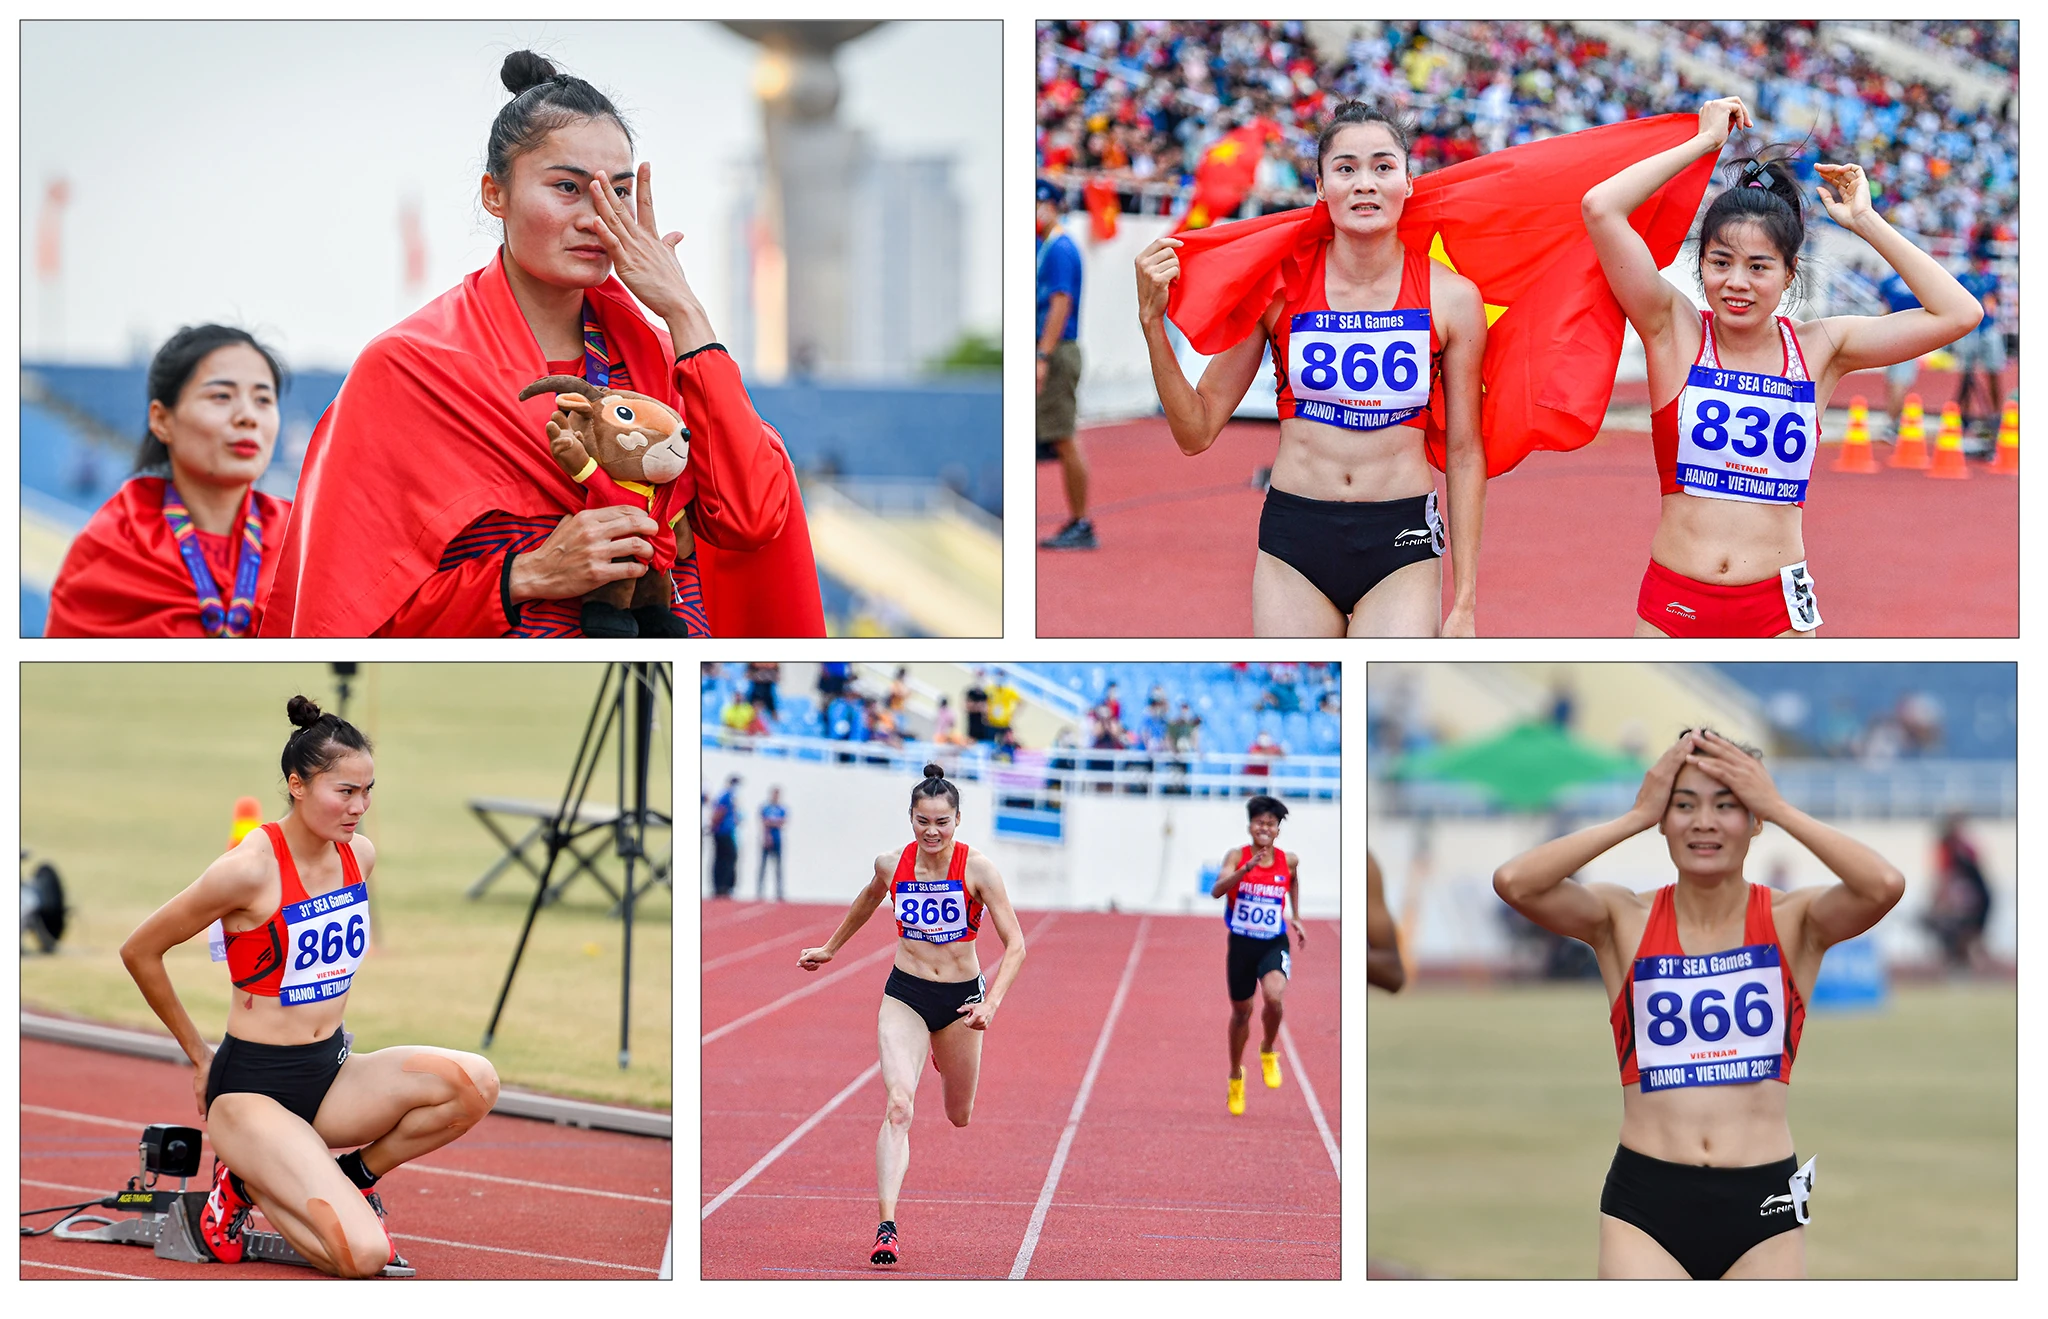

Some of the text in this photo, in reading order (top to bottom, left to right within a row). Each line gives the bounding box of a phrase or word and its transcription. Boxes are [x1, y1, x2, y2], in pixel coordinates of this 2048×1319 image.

[1339, 314, 1361, 329] SEA
[1365, 315, 1404, 329] Games
[1301, 341, 1418, 391] 866
[1738, 375, 1760, 392] SEA
[1763, 378, 1794, 398] Game
[1303, 401, 1335, 421] HANOI
[1344, 410, 1389, 426] VIETNAM
[1339, 399, 1381, 407] VIETNAM
[1691, 399, 1806, 463] 836
[1725, 461, 1768, 474] VIETNAM
[1685, 468, 1718, 487] HANOI
[1728, 475, 1775, 496] VIETNAM
[1777, 483, 1799, 498] 2022
[1665, 606, 1697, 620] LI-NING
[1239, 881, 1285, 898] PILIPINAS
[313, 898, 328, 914] SEA
[328, 892, 354, 906] Games
[901, 898, 960, 925] 866
[1237, 905, 1276, 925] 508
[294, 914, 365, 971] 866
[317, 968, 346, 979] VIETNAM
[1682, 958, 1708, 976] SEA
[1710, 952, 1752, 973] Games
[288, 986, 316, 1002] HANOI
[1646, 981, 1774, 1046] 866
[1690, 1049, 1737, 1060] VIETNAM
[1650, 1067, 1686, 1087] HANOI
[1695, 1061, 1748, 1083] VIETNAM
[1760, 1204, 1794, 1216] LI-NIN
